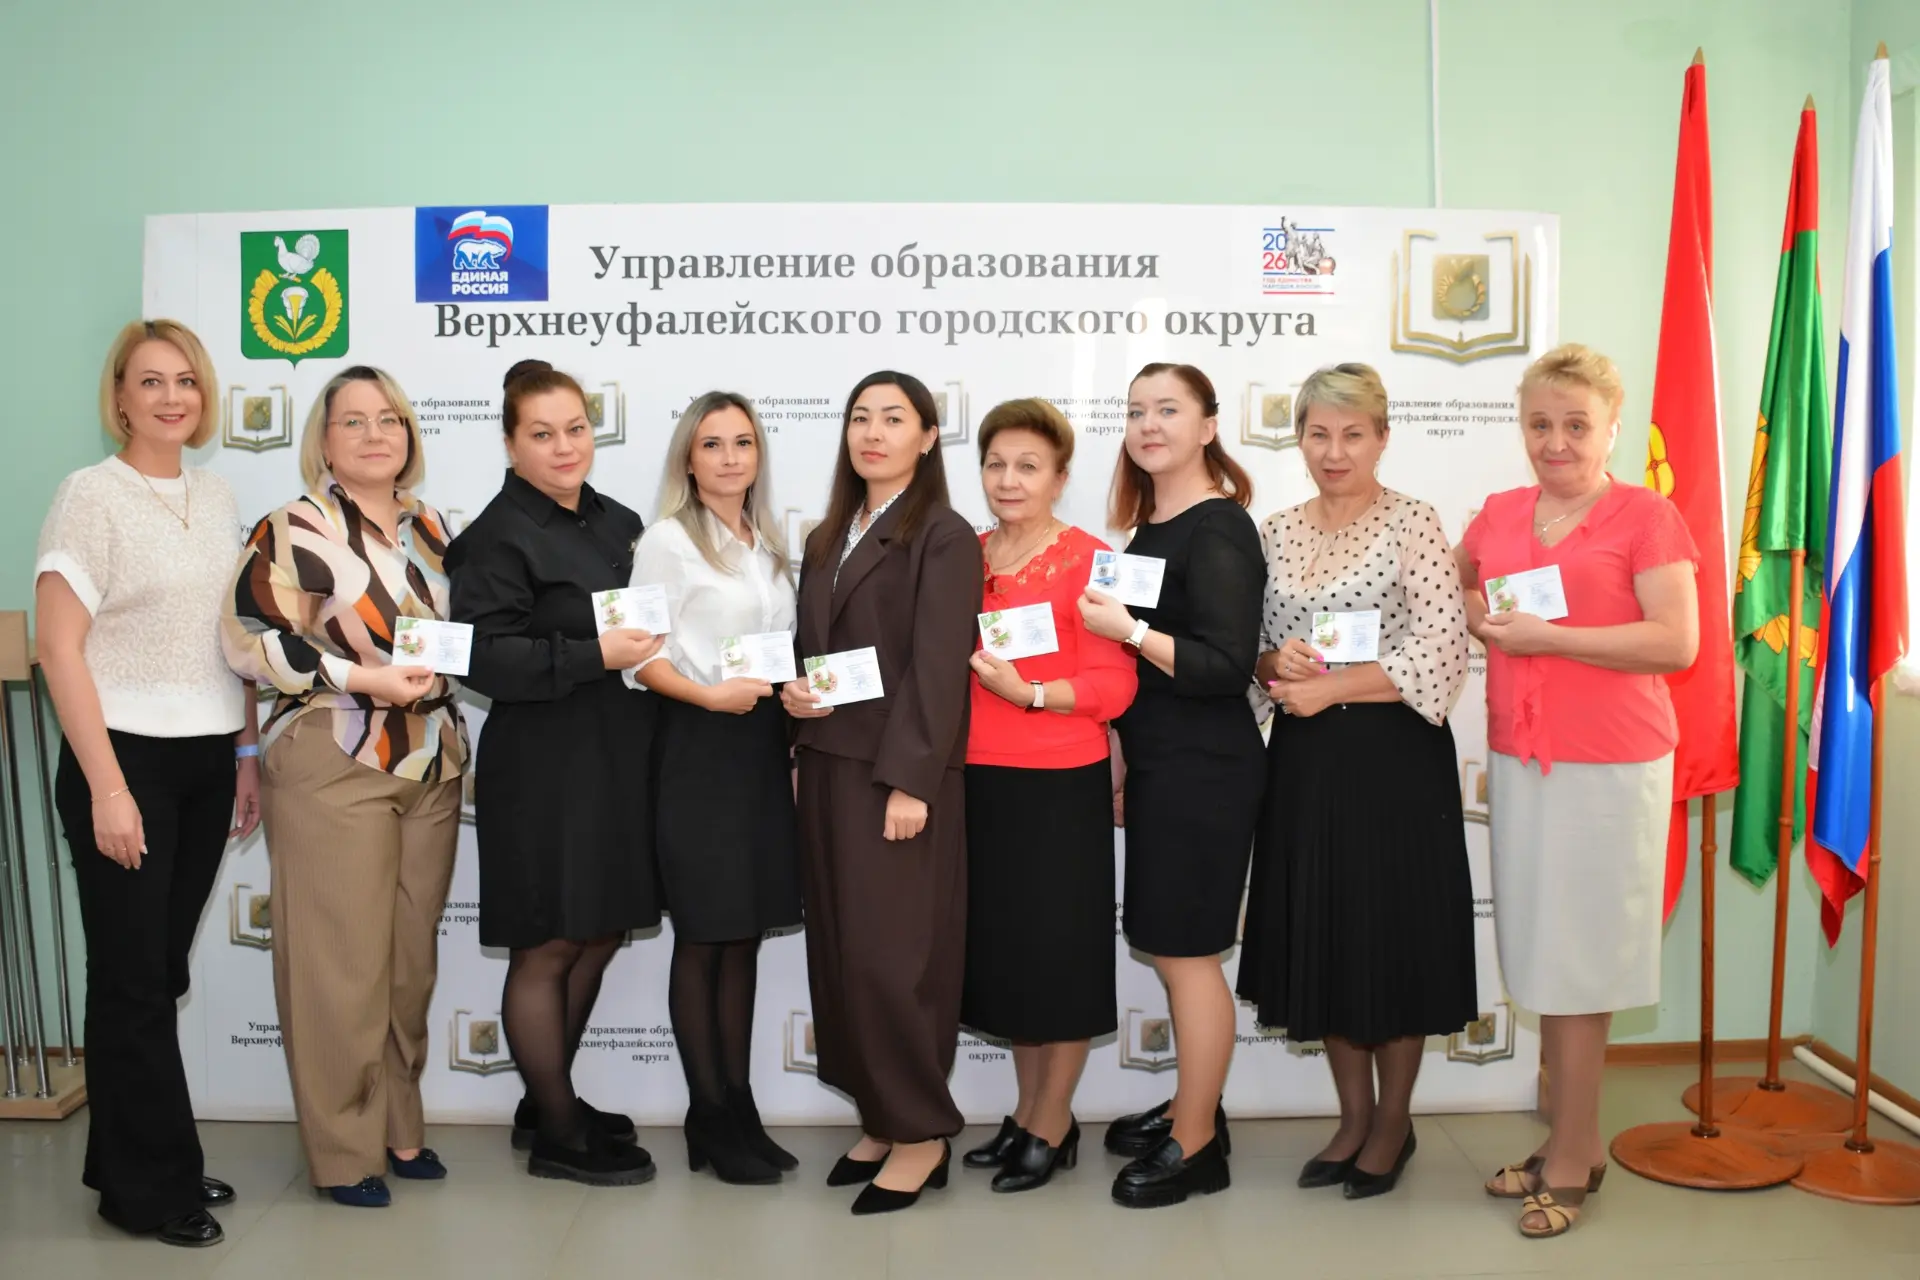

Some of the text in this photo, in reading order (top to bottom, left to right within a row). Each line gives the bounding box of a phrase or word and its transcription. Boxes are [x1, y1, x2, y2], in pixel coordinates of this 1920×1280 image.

[1262, 233, 1288, 251] 20
[589, 242, 1160, 290] Управление образования
[1262, 252, 1288, 270] 26
[451, 271, 509, 284] ЕДИНАЯ
[451, 283, 509, 295] РОССИЯ
[434, 301, 1318, 348] Верхнеуфалейского городского округа
[421, 398, 490, 410] образования
[758, 396, 830, 406] образования
[1446, 399, 1515, 411] образования
[1085, 426, 1124, 437] округа
[1426, 428, 1465, 439] округа
[968, 1052, 1007, 1063] округа
[1301, 1047, 1326, 1057] окру
[631, 1054, 670, 1065] округа
